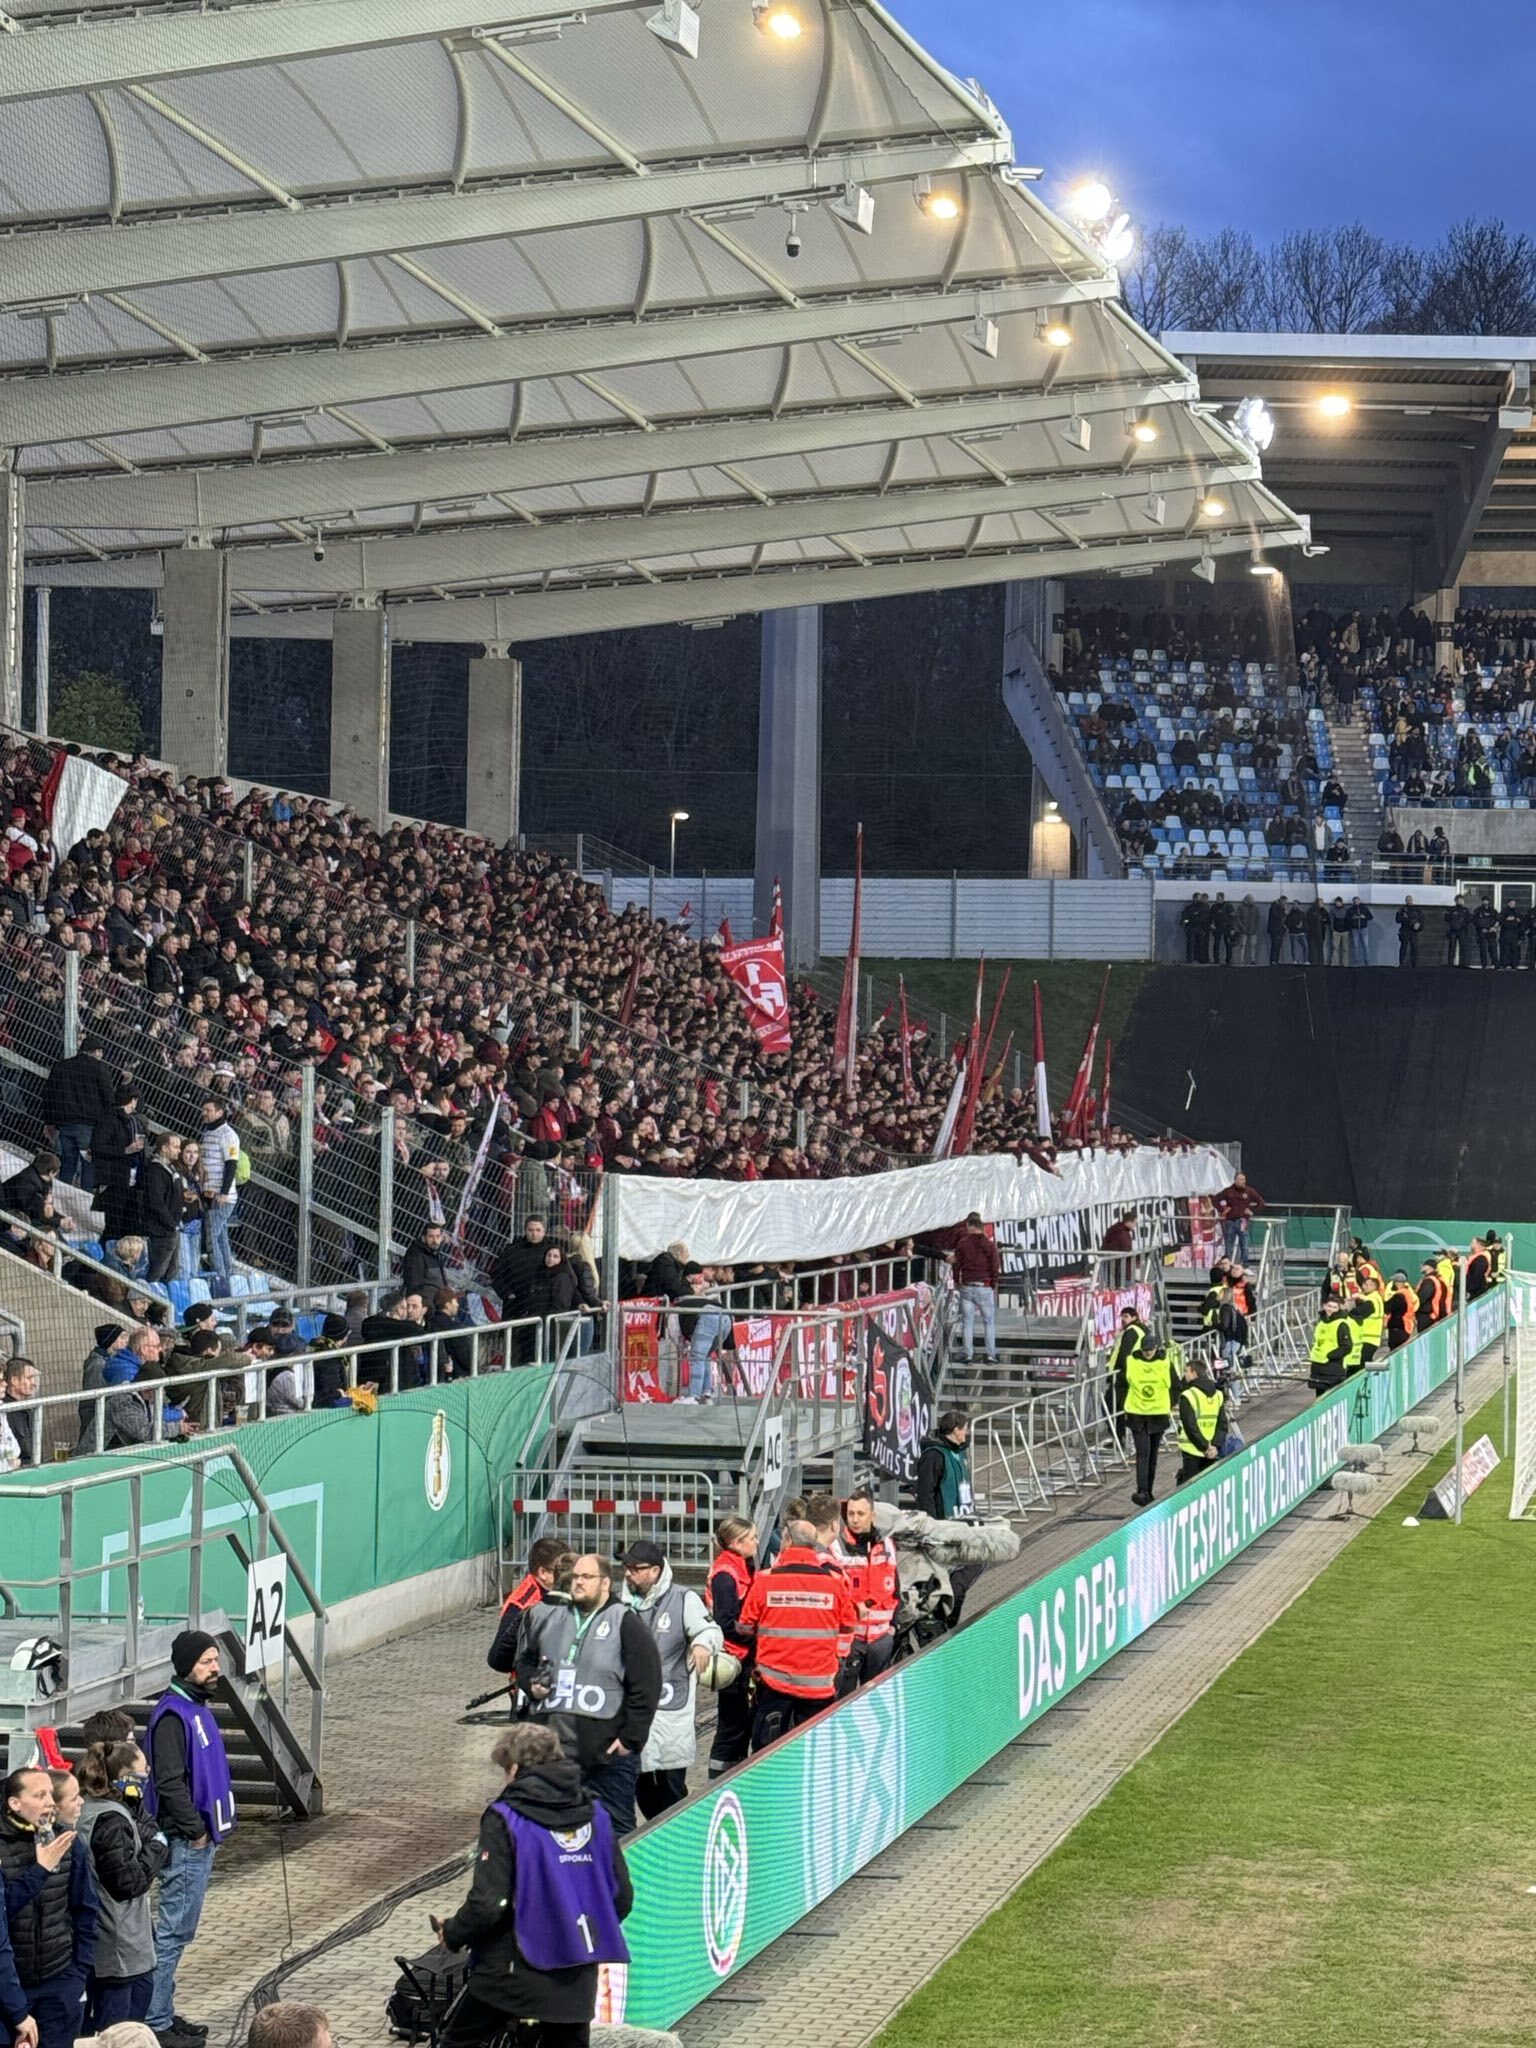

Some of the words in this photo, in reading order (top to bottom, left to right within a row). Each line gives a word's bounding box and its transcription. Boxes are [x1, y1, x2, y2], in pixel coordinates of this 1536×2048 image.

[1018, 1587, 1066, 1721] DAS
[1242, 1444, 1267, 1541] FÜR
[1270, 1423, 1313, 1518] DEINEN
[1313, 1398, 1349, 1481] VEREIN
[249, 1580, 284, 1647] A2
[576, 1913, 595, 1954] 1
